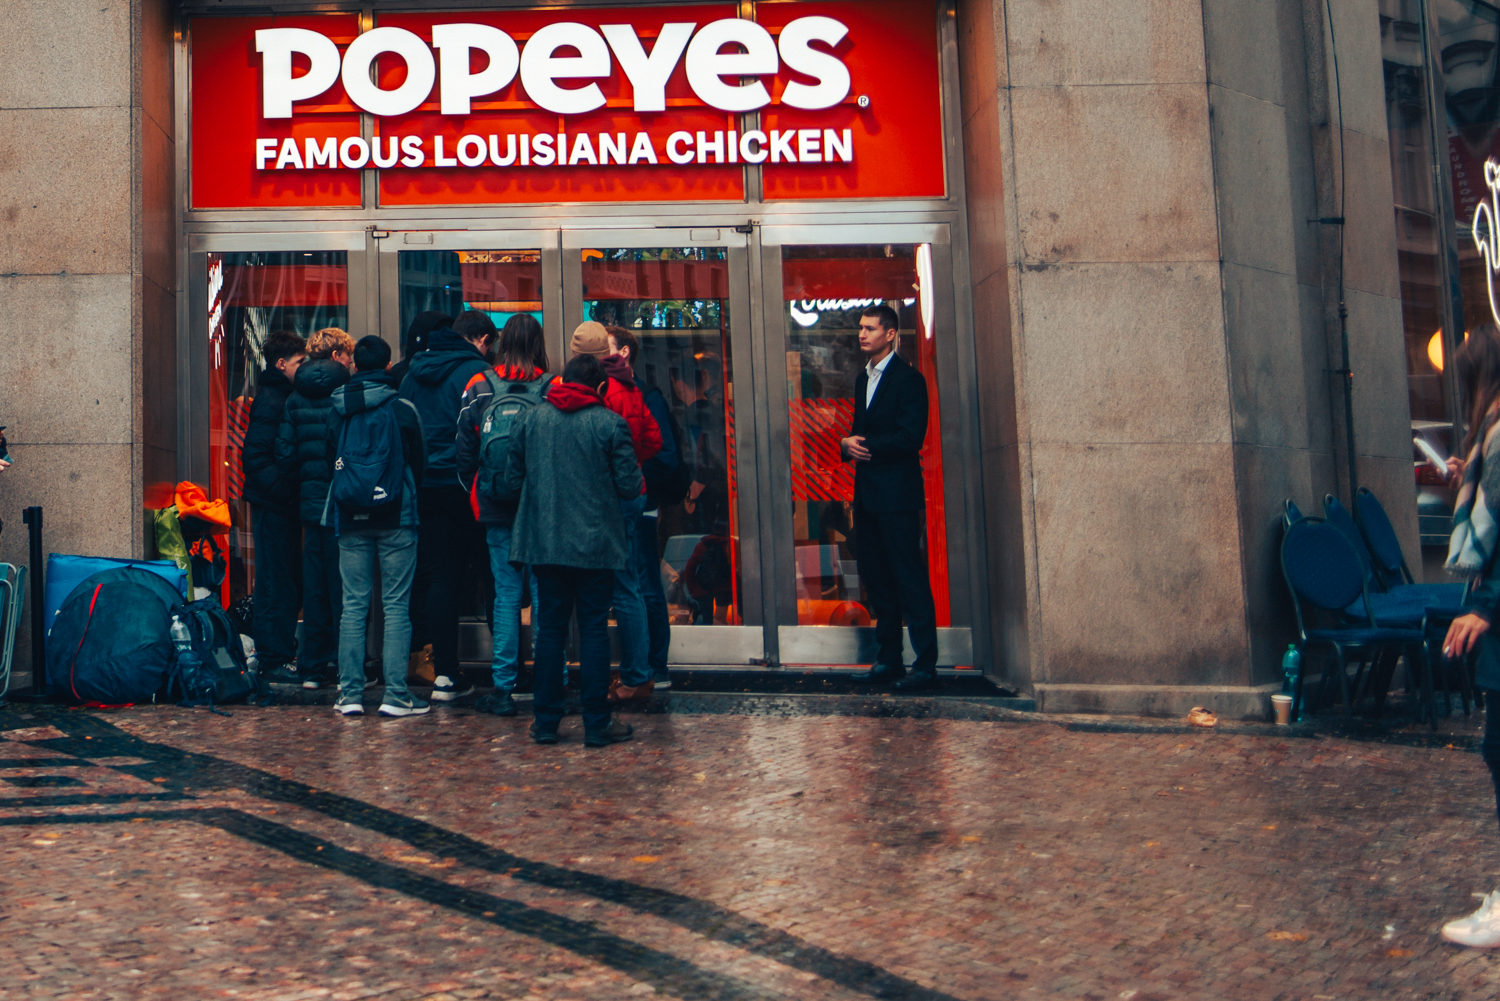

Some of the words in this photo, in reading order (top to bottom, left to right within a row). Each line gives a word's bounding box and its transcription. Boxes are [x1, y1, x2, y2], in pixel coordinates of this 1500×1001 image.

[255, 133, 425, 171] FAMOUS
[434, 130, 657, 169] LOUISIANA
[666, 127, 853, 166] CHICKEN
[1448, 137, 1477, 221] AUNDROMAT
